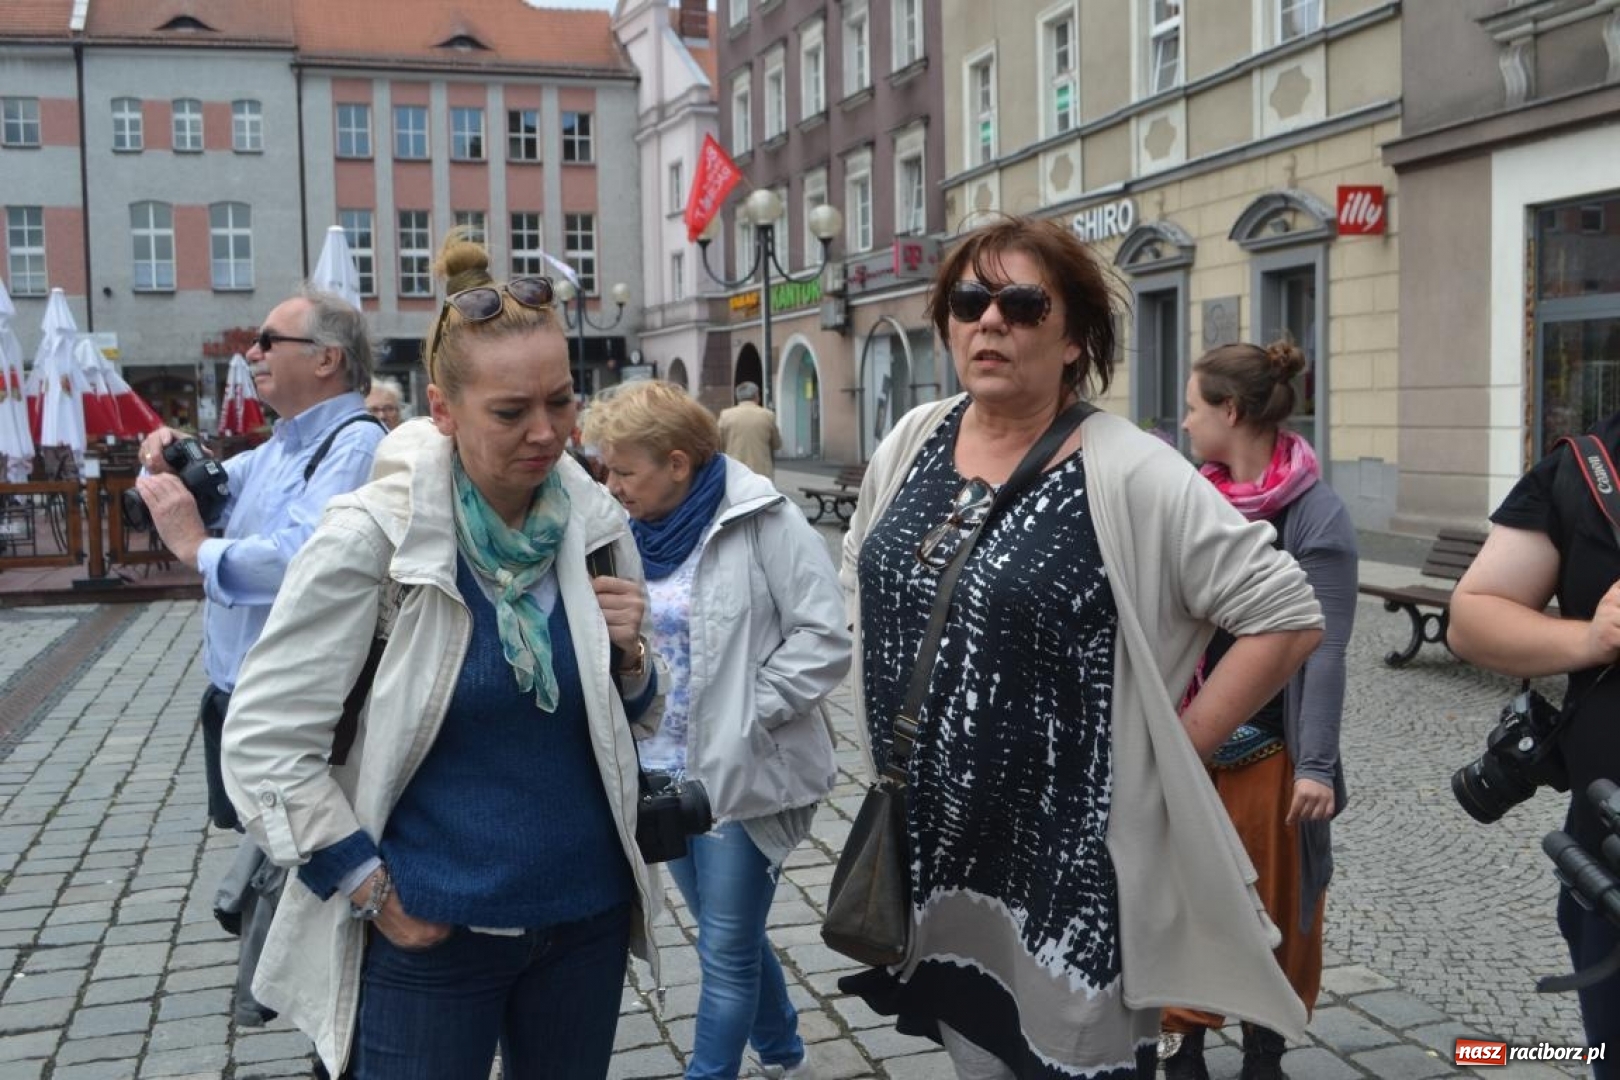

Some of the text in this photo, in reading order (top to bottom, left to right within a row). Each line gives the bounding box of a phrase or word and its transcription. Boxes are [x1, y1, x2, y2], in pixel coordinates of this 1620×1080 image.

[1072, 199, 1133, 242] SHIRO
[1340, 191, 1382, 232] illy
[1588, 456, 1612, 493] Canon
